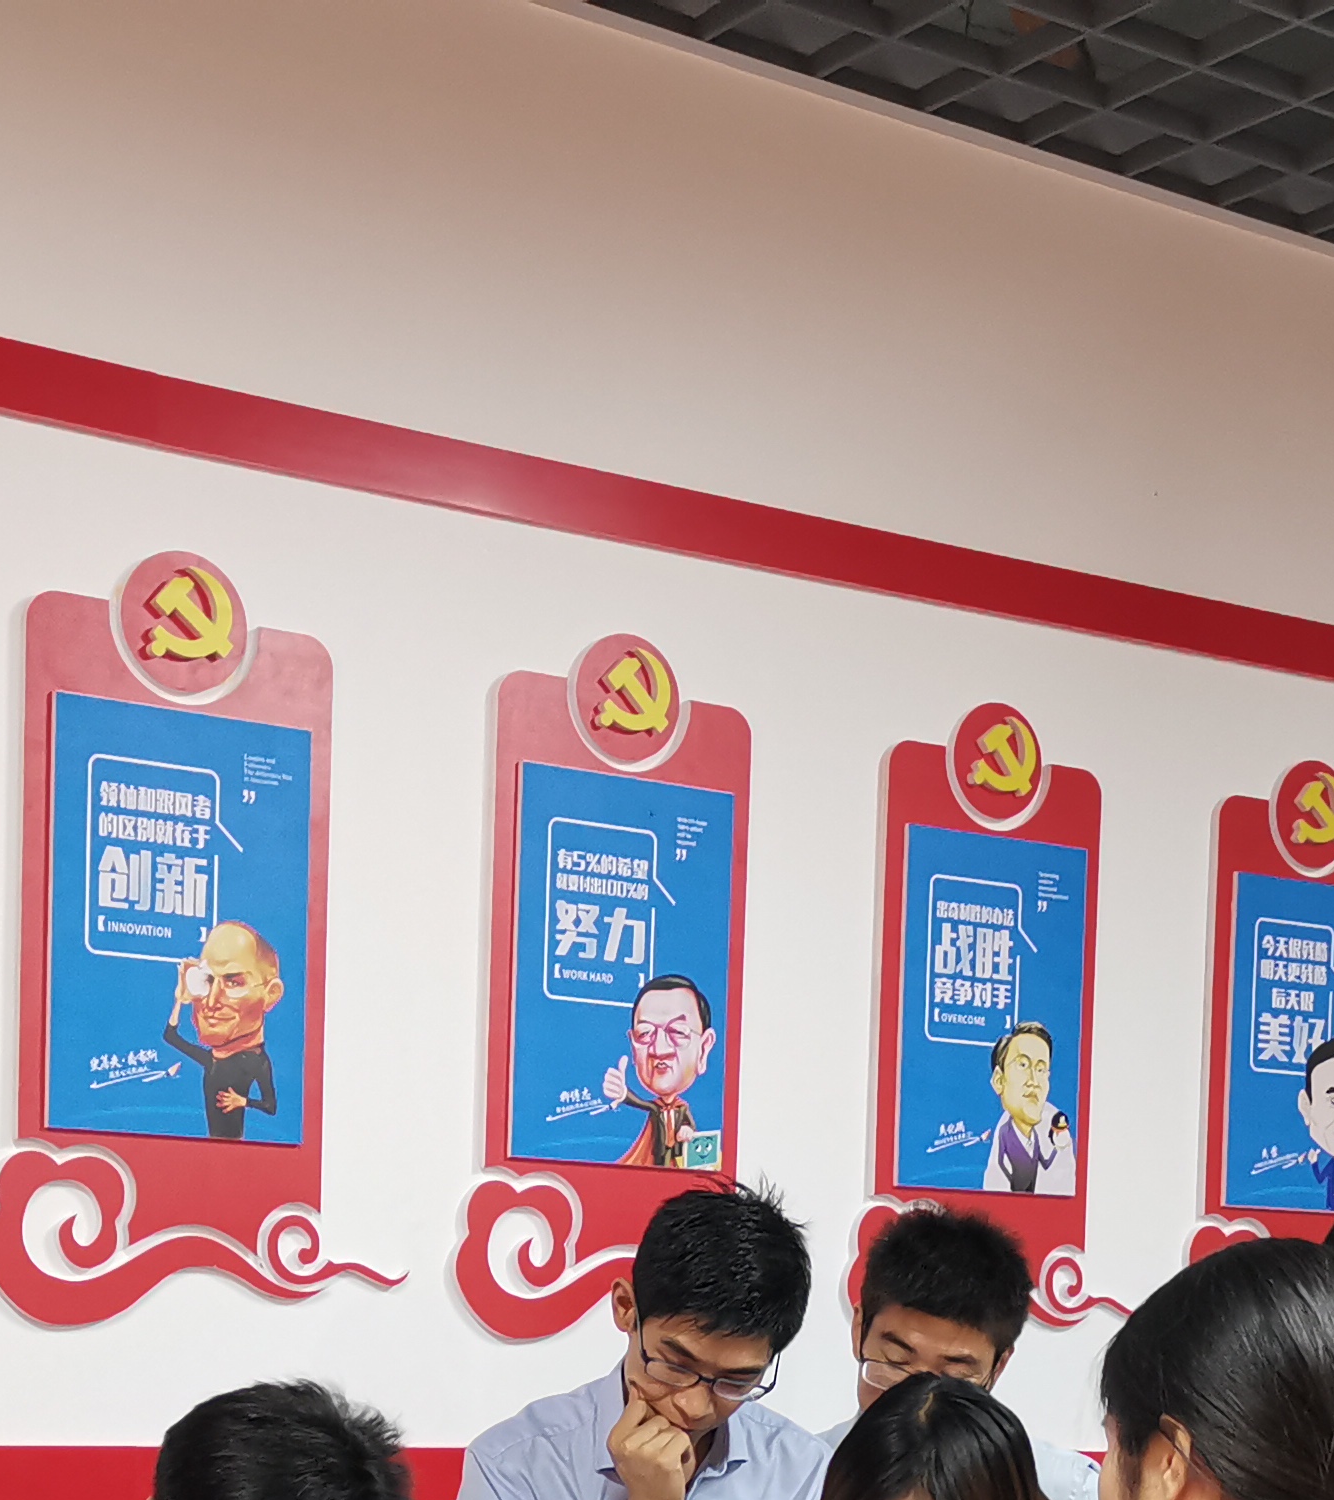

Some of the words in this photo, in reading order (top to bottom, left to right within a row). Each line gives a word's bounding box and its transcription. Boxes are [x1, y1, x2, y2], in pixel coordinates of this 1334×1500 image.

[99, 780, 212, 820] 领袖和跟风者
[98, 811, 212, 849] 的区别就在于
[556, 848, 649, 880] 有5%的希望
[98, 845, 209, 918] 创新
[556, 872, 649, 900] 就要付出100%的
[107, 920, 172, 939] INNOVATION
[555, 900, 646, 965] 努力
[934, 922, 1014, 981] 战胜
[562, 968, 588, 981] WORK
[589, 971, 614, 985] HARD
[934, 978, 1012, 1010] 竞争对手
[1271, 987, 1315, 1013] 后天很
[940, 1012, 986, 1027] OVERCOME
[1258, 1013, 1326, 1064] 美好
